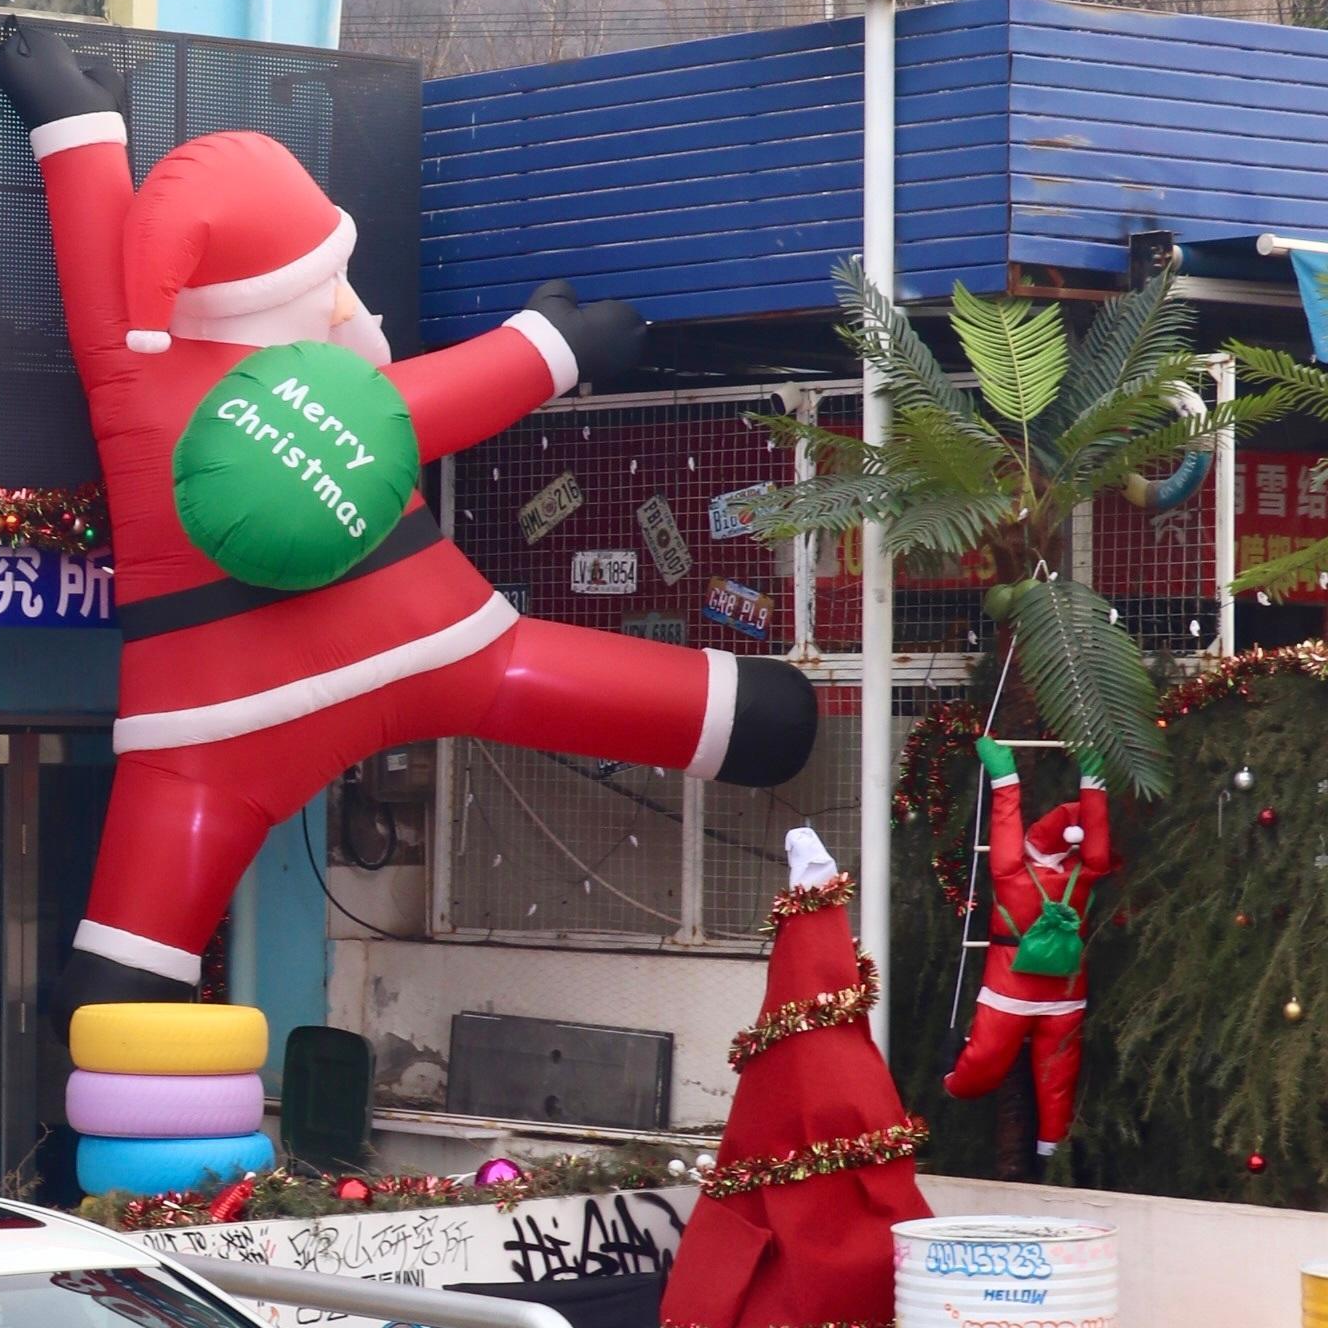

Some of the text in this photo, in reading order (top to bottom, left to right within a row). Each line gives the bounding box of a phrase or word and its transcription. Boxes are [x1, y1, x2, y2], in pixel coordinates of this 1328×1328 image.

[218, 398, 367, 538] Christmas
[272, 378, 374, 469] Merry
[663, 548, 685, 576] 007
